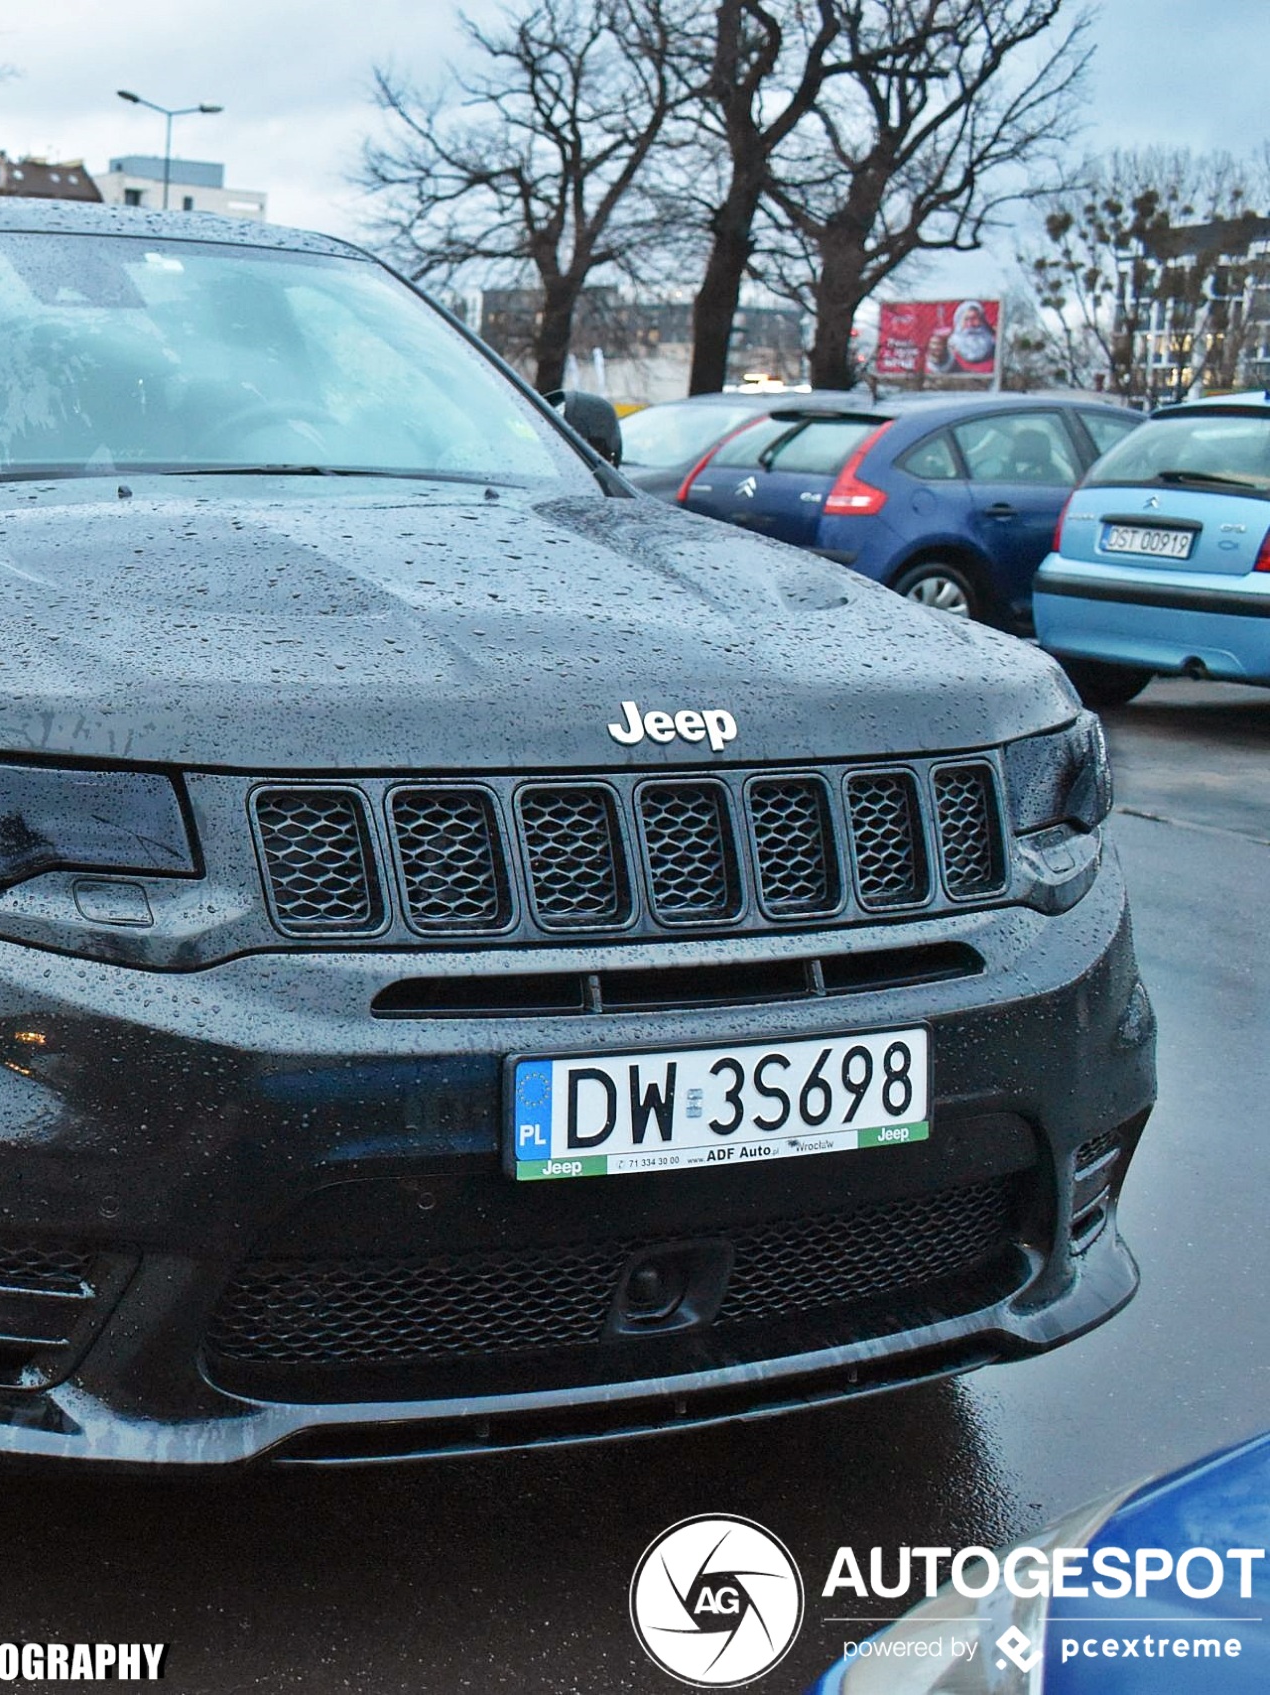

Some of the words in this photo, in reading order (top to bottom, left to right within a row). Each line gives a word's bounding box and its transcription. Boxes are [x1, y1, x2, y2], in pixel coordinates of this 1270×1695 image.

[1108, 528, 1139, 548] DST
[1140, 531, 1189, 554] 00919
[607, 701, 738, 752] Jeep
[567, 1062, 677, 1149] DW
[708, 1041, 912, 1136] 3S698
[519, 1124, 547, 1147] PL
[877, 1127, 910, 1143] Jeep
[542, 1160, 583, 1177] Jeep
[629, 1158, 638, 1168] 71
[641, 1157, 656, 1167] 334
[658, 1156, 668, 1166] 30
[669, 1155, 680, 1165] 00
